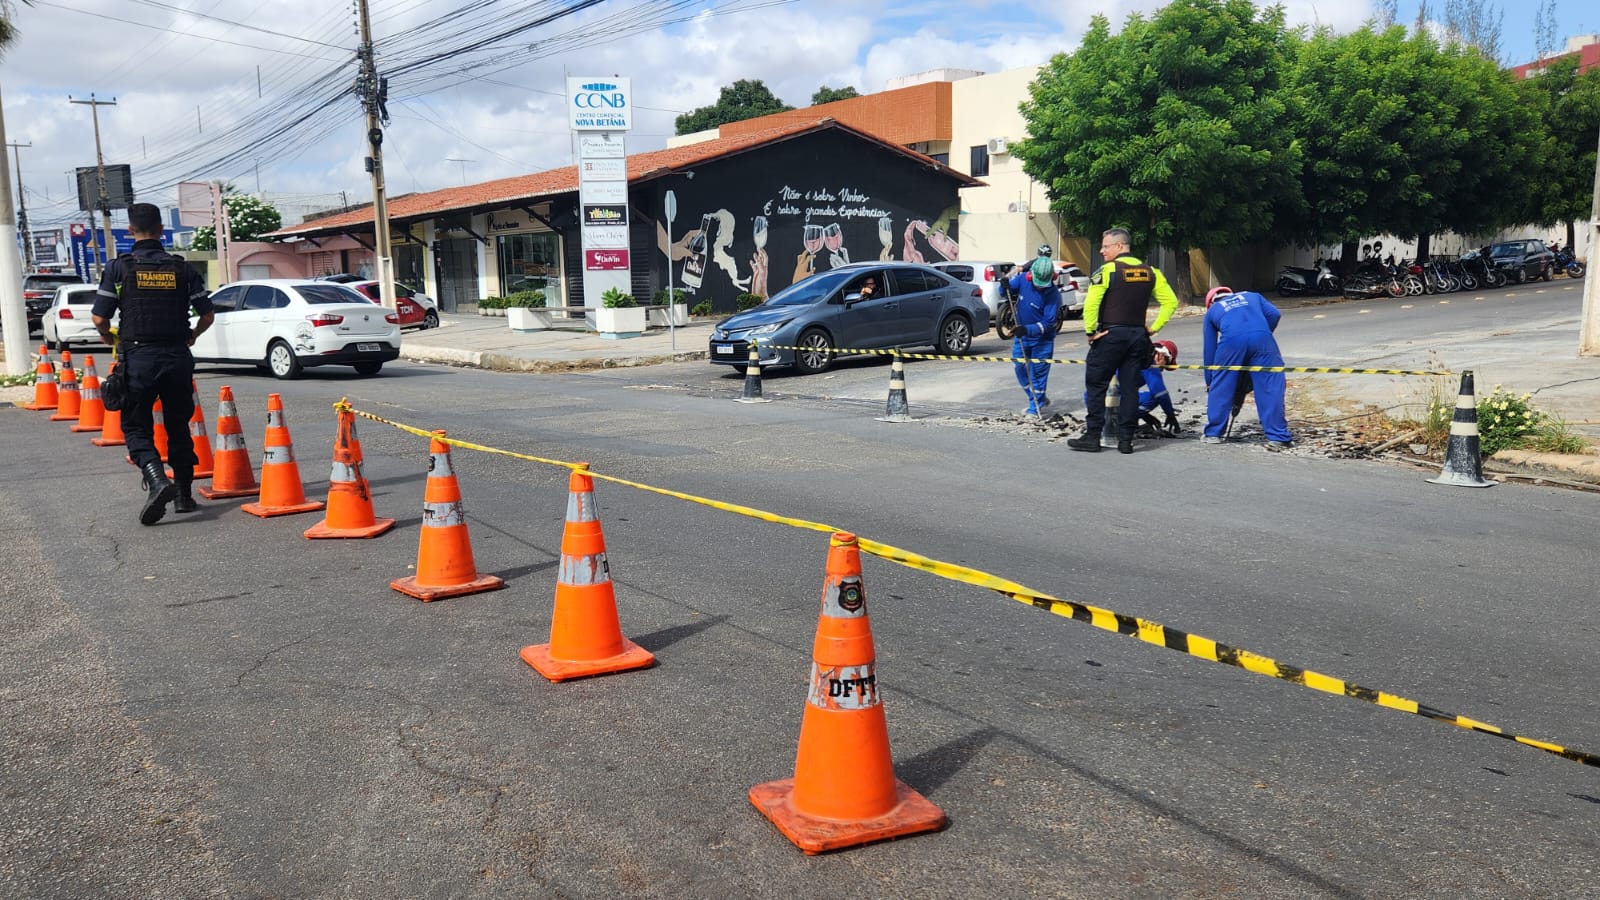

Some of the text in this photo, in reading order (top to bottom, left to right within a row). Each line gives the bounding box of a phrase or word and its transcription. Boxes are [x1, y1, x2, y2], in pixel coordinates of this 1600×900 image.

[574, 92, 626, 108] CCNB
[596, 117, 626, 126] BETÂNIA
[778, 185, 870, 203] Não é sobre Vinhos
[763, 199, 892, 222] É sobre grandes Experiências
[138, 271, 175, 281] TRÂNSITO
[828, 674, 877, 698] DFTT
